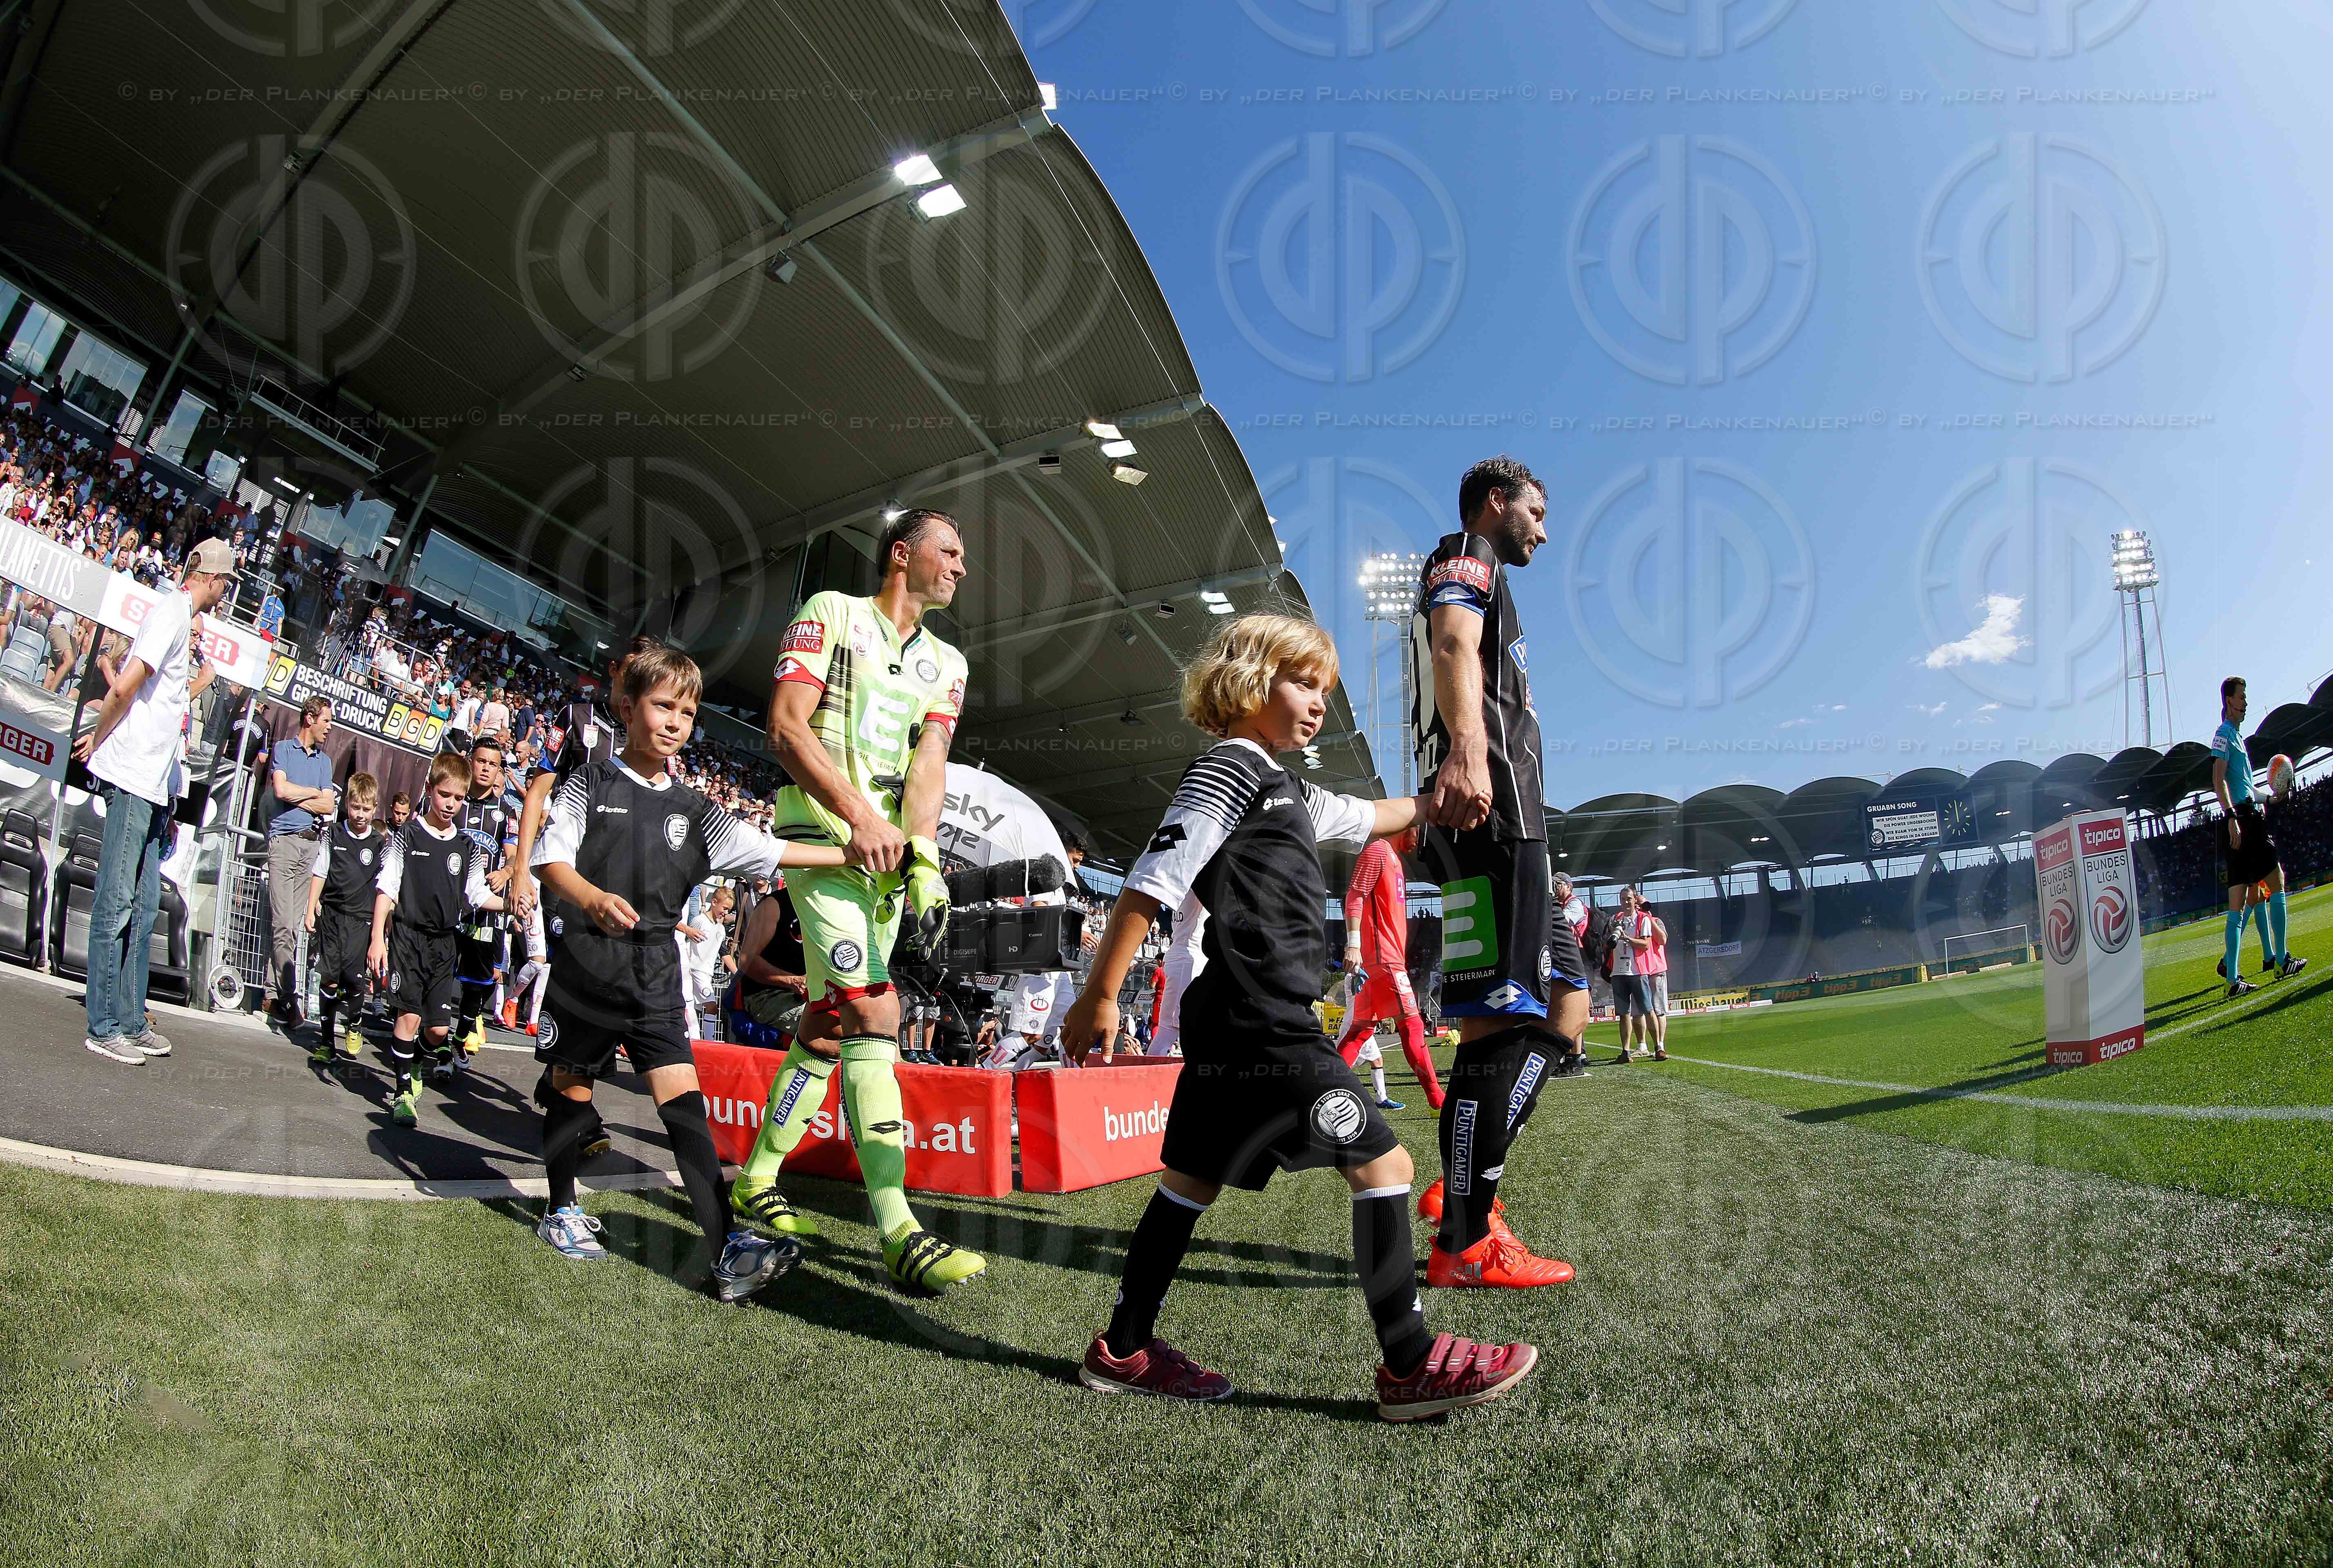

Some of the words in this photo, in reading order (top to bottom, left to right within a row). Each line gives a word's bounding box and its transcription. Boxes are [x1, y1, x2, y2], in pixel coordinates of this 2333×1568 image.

[1431, 559, 1486, 579] KLEINE
[295, 664, 388, 715] BESCHRIFTUNG
[292, 684, 383, 733] GRK-DRUCK
[234, 720, 262, 737] PUNTAMER
[0, 728, 47, 761] GER
[943, 793, 1005, 831] sky
[1867, 804, 1896, 812] GRUABN
[2084, 828, 2121, 846] tipico
[2040, 839, 2068, 860] tipico
[2087, 855, 2126, 872] BUNDES
[2042, 866, 2073, 886] BUNDES
[2097, 870, 2119, 884] LIGA
[2050, 882, 2068, 897] LIGA
[1698, 944, 1739, 953] ATZGERSDORF
[2053, 1048, 2083, 1065] tipico
[2100, 1037, 2136, 1060] tipico
[774, 1070, 811, 1125] UNTIGAMER
[1320, 1092, 1336, 1104] STURM
[1347, 1131, 1358, 1140] 1909
[1454, 1106, 1473, 1191] PUNTIGAMER
